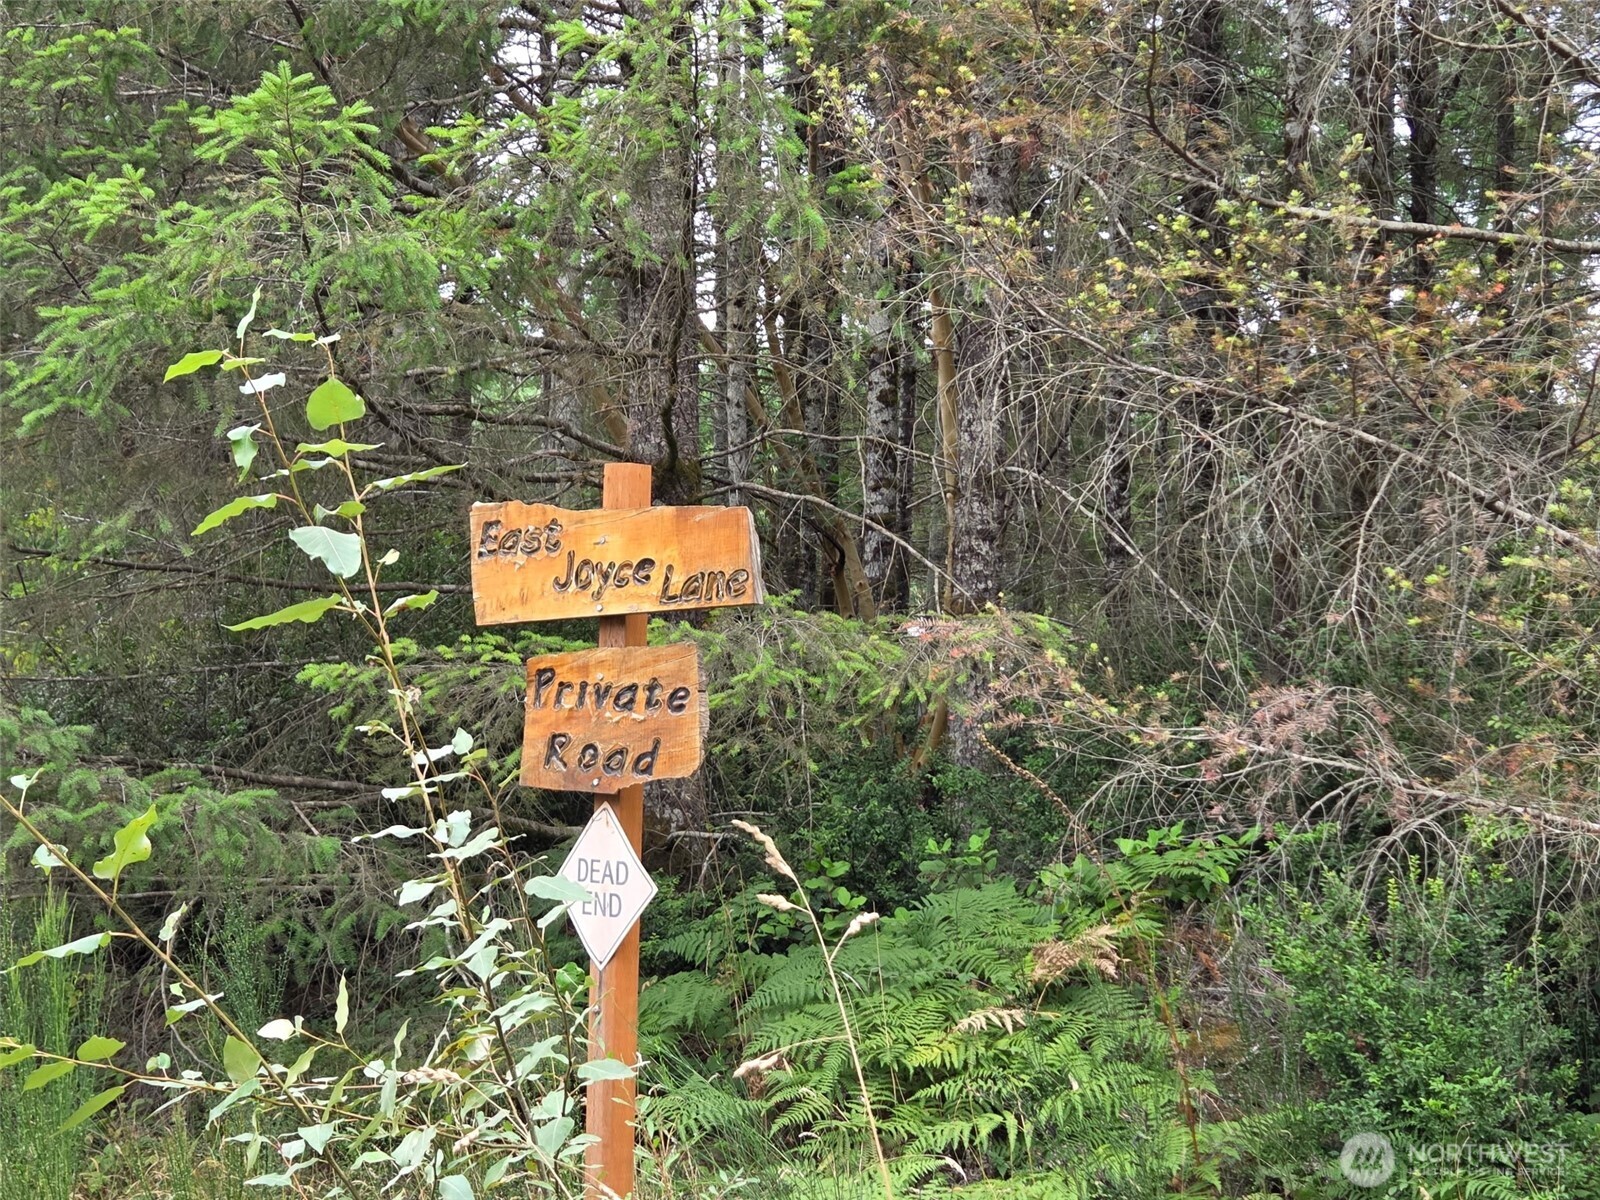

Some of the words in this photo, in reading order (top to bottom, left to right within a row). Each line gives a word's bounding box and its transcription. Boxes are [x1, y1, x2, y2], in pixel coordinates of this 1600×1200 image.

[477, 518, 564, 559] East
[553, 550, 656, 600] Joyce
[659, 564, 749, 604] Lane
[534, 667, 690, 715] Private
[544, 732, 661, 777] Road
[577, 858, 629, 886] DEAD
[581, 891, 622, 918] END
